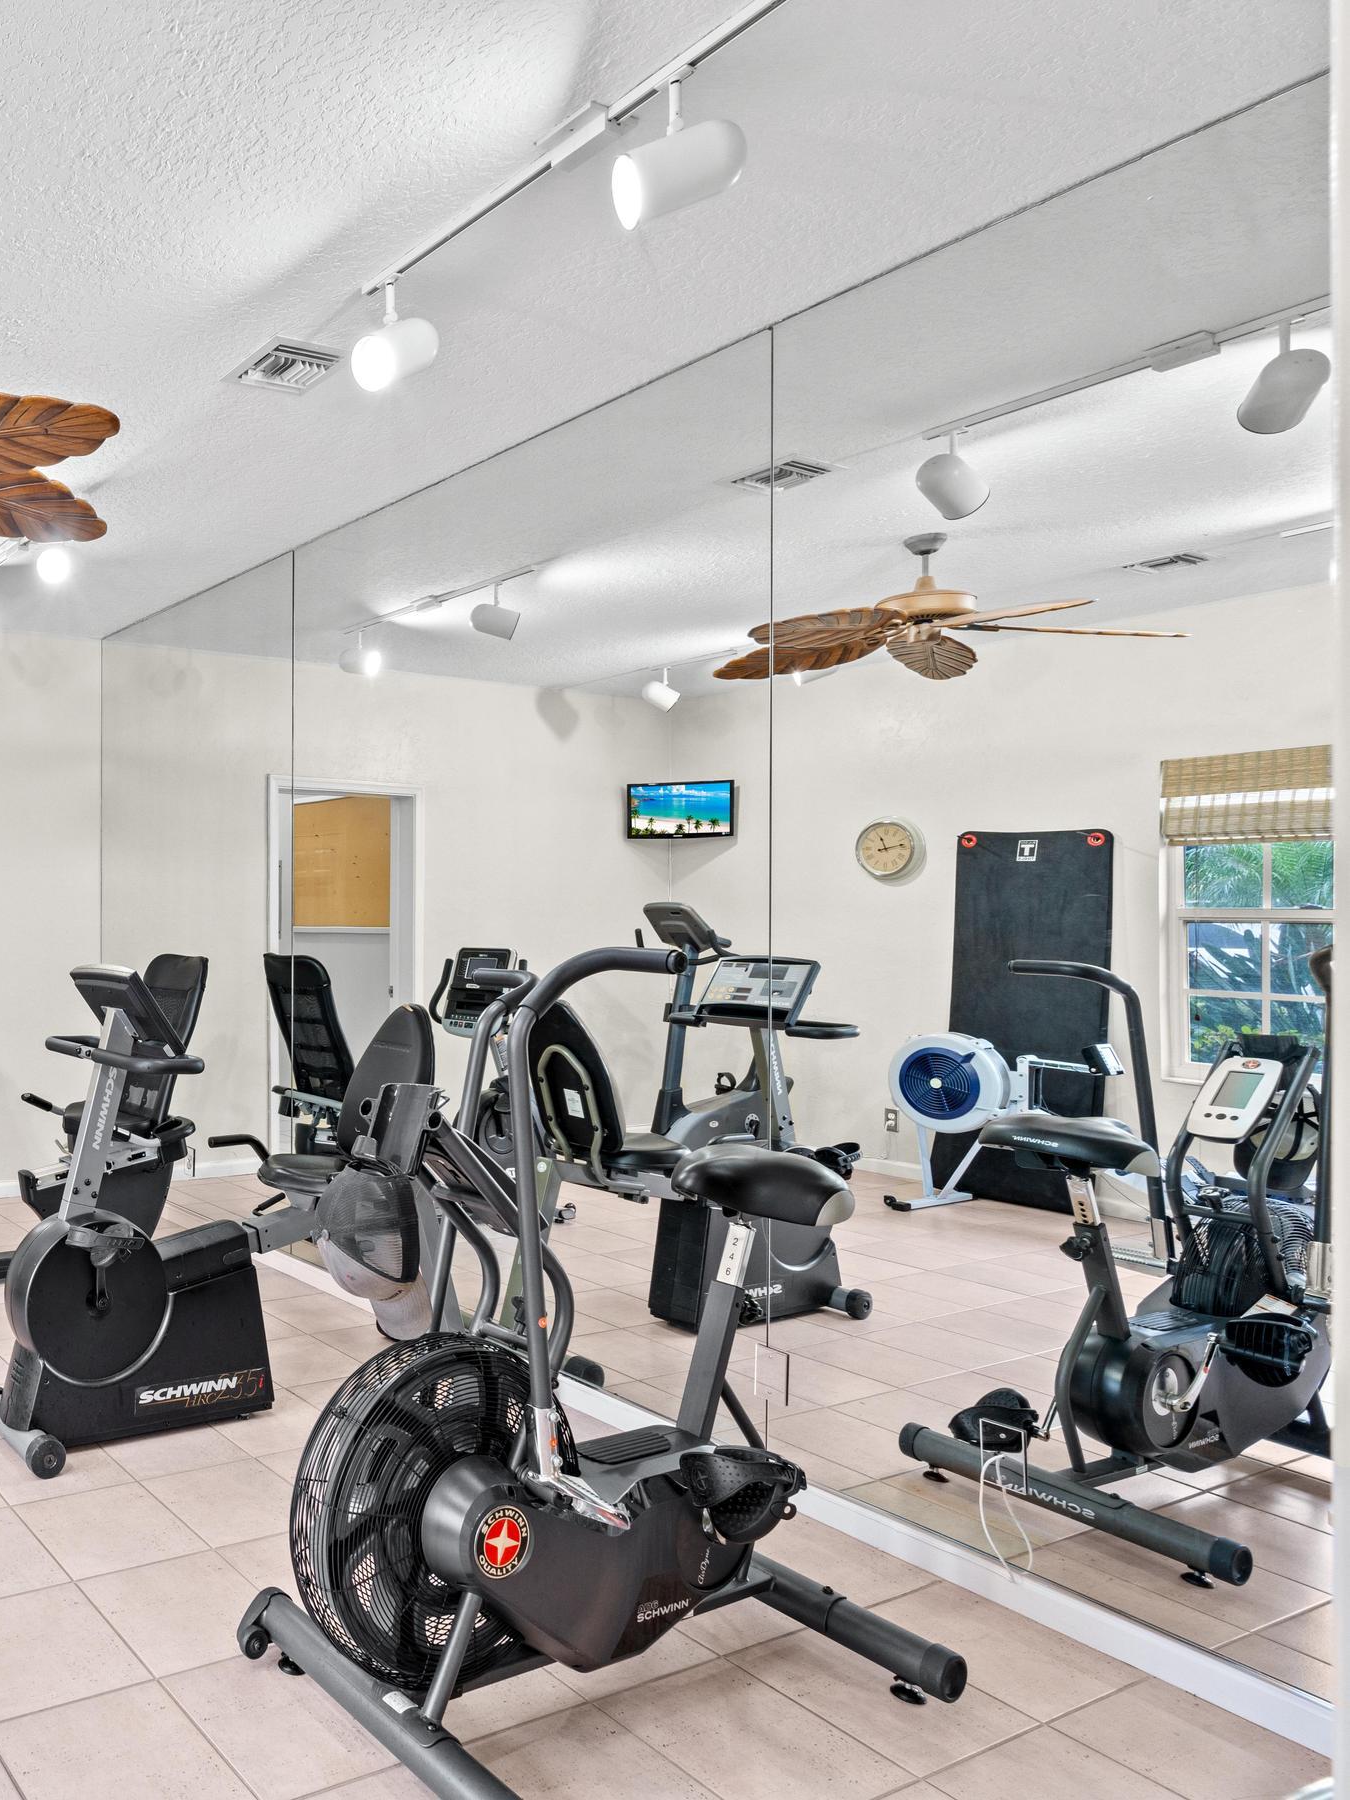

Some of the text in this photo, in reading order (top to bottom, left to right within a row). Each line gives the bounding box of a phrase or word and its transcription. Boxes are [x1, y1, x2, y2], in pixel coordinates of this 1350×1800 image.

[92, 1066, 117, 1151] SCHWINN
[732, 1237, 738, 1246] 2
[725, 1267, 731, 1276] 6
[139, 1377, 238, 1404] SCHWINN
[481, 1509, 528, 1537] SCHWINN
[479, 1554, 519, 1575] QUALITY
[637, 1598, 689, 1623] SCHWINN
